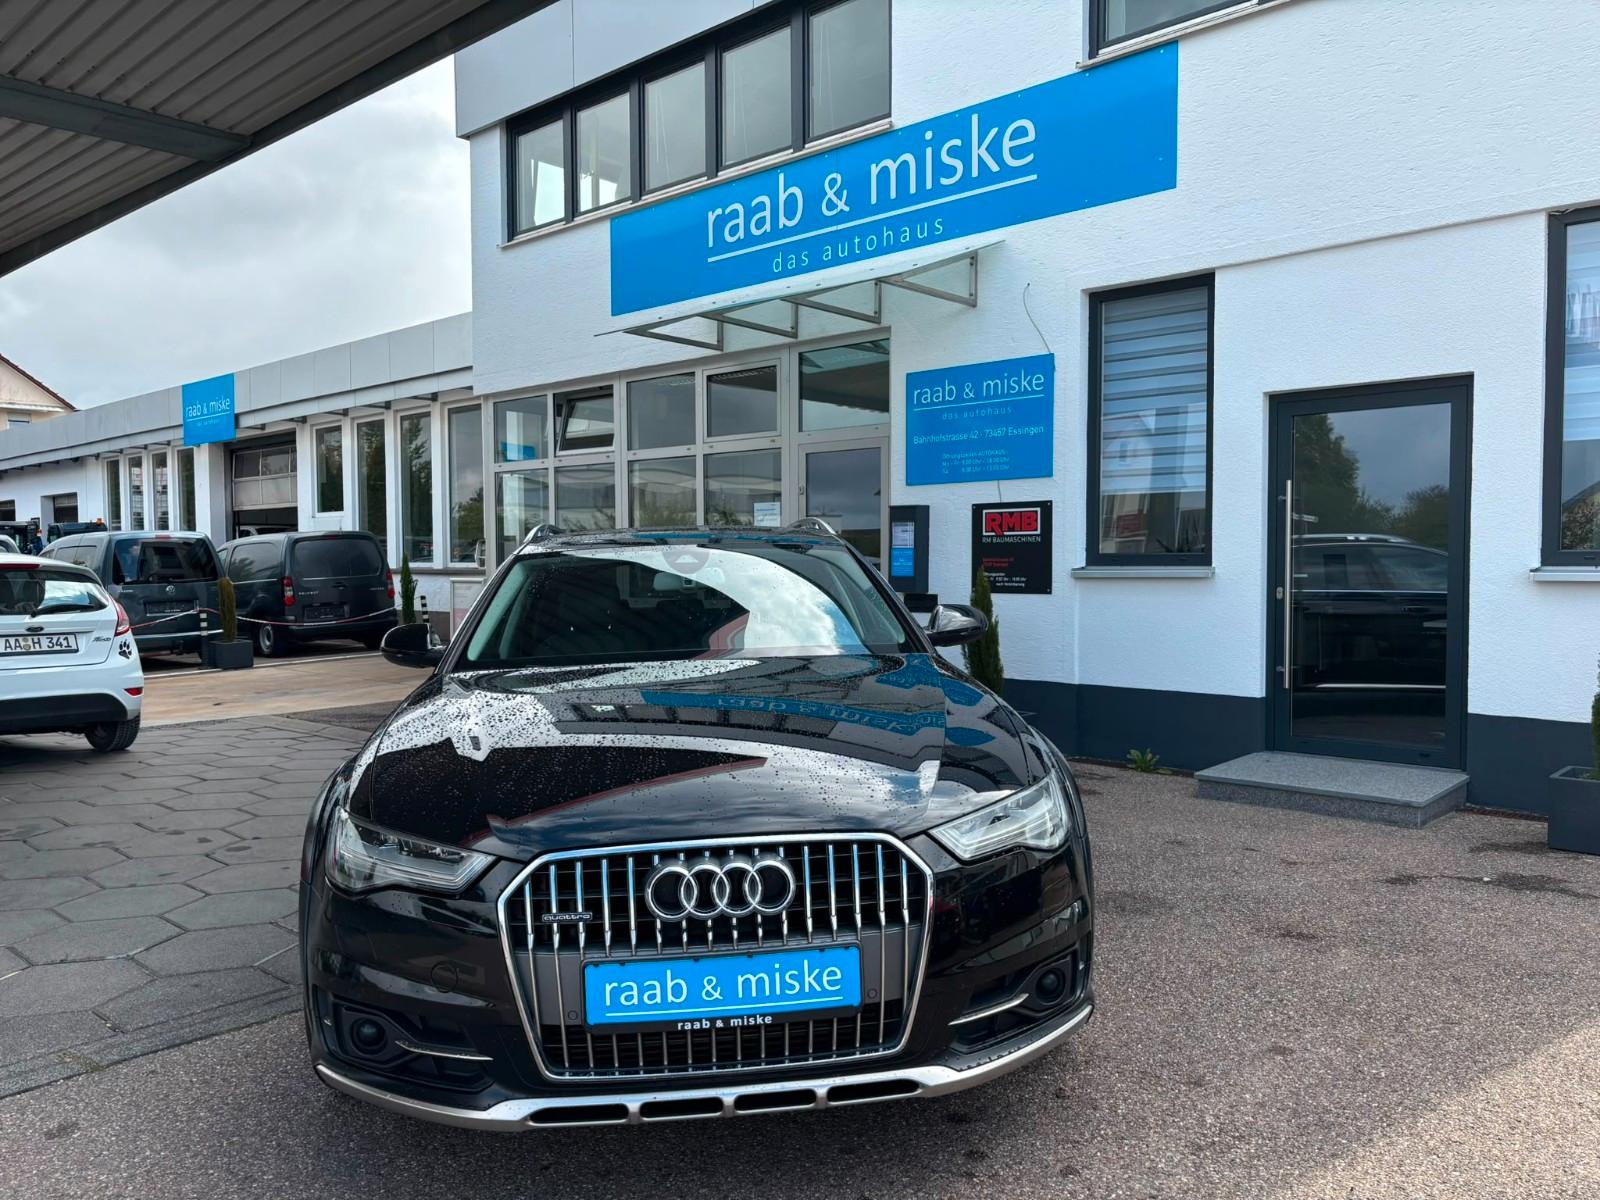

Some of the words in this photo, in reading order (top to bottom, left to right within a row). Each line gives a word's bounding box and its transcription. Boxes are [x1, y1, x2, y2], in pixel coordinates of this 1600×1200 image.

[707, 172, 804, 248] raab
[821, 172, 850, 217] &
[870, 113, 1036, 205] miske
[772, 251, 809, 272] das
[822, 218, 944, 261] autohaus
[913, 379, 957, 405] raab
[963, 382, 975, 399] &
[983, 369, 1045, 396] miske
[185, 399, 202, 417] raab
[209, 394, 231, 413] miske
[942, 410, 959, 420] das
[963, 407, 1012, 418] autohaus
[913, 432, 968, 444] Bahnhofstrasse
[969, 430, 979, 440] 42
[1008, 426, 1044, 437] Essingen
[984, 510, 1039, 536] RMB
[992, 535, 1041, 544] BAUMASCHINEN
[4, 638, 23, 651] AA
[32, 637, 42, 649] H
[46, 636, 73, 649] 341
[543, 913, 591, 921] quattro
[605, 969, 688, 1007] raab
[701, 975, 723, 1001] &
[737, 959, 843, 999] miske
[677, 1019, 711, 1031] raab
[715, 1019, 724, 1029] &
[730, 1014, 773, 1027] miske
